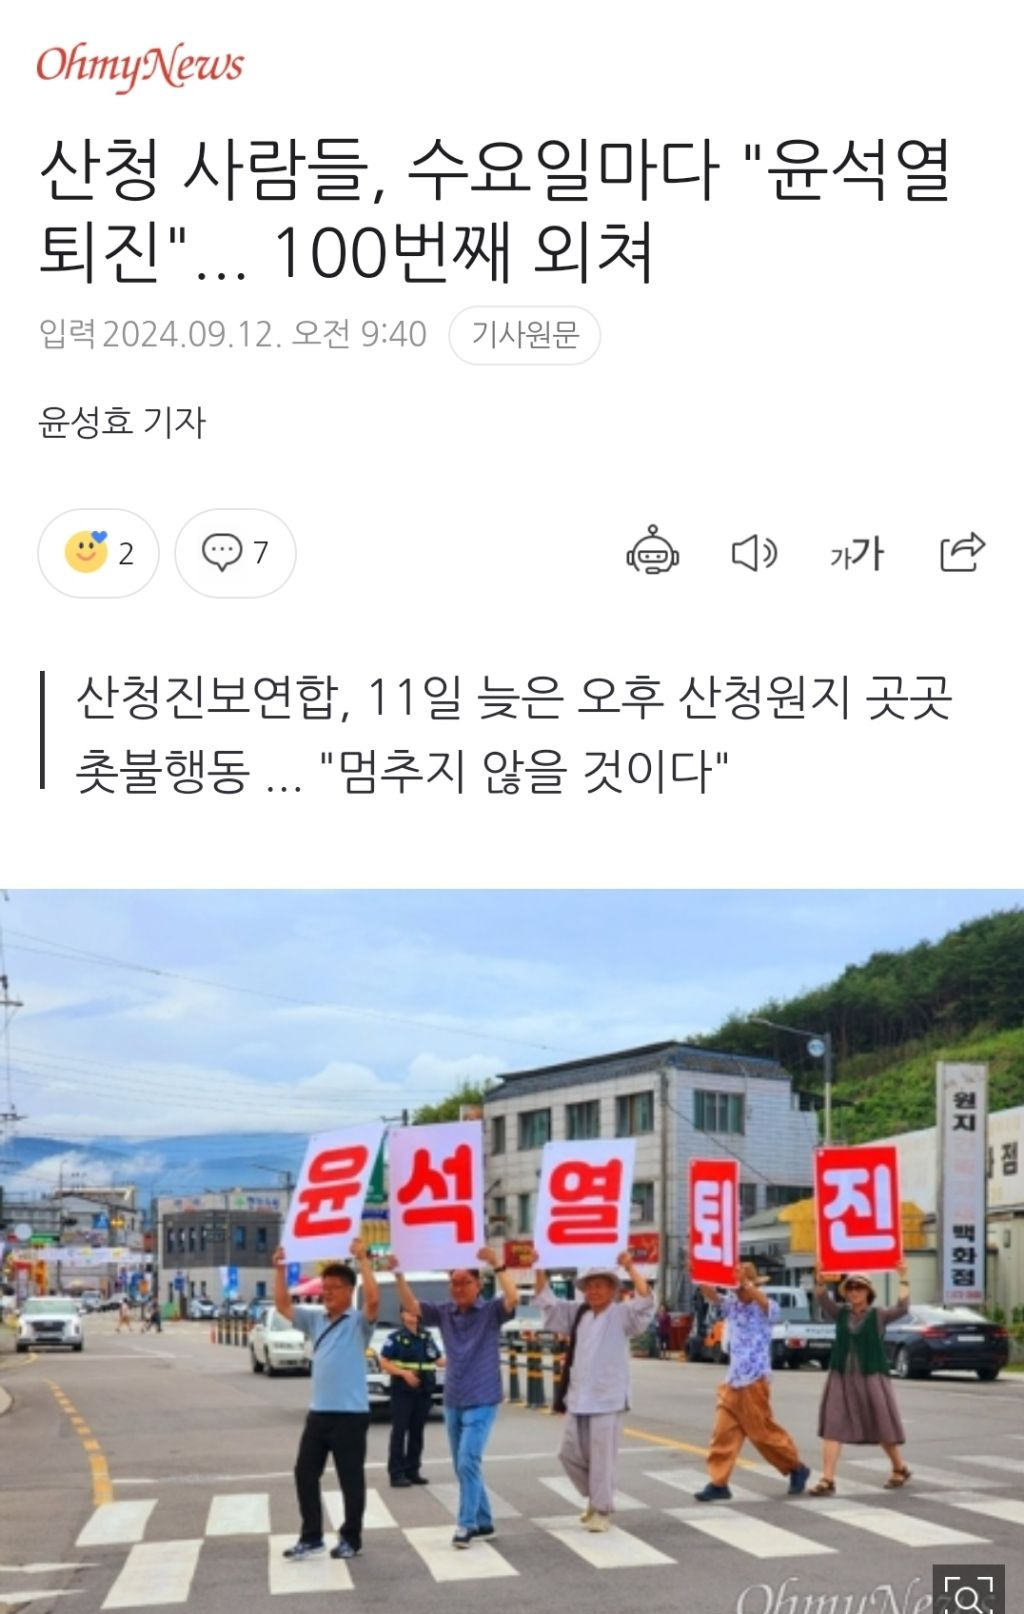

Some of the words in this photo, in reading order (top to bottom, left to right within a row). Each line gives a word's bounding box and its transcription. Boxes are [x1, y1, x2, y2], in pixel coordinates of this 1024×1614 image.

[37, 42, 245, 95] OhmyNews
[41, 138, 155, 201] 산청
[184, 138, 383, 204] 사람들,
[408, 138, 720, 201] 수요일마다
[745, 138, 947, 201] "윤석열
[278, 221, 508, 284] 100번째
[535, 221, 649, 284] 외쳐
[41, 319, 93, 349] 입력
[104, 321, 281, 347] 2024.09.12.
[293, 319, 348, 349] 오전
[362, 321, 426, 347] 9:40
[474, 321, 579, 349] 기사원문
[38, 406, 133, 440] 윤성효
[145, 406, 206, 439] 기자
[119, 542, 133, 565] 2
[254, 541, 268, 564] 7
[77, 675, 348, 723] 산청진보연합,
[371, 675, 460, 720] 11일
[478, 675, 564, 720] 늦은
[578, 675, 664, 720] 오후
[679, 675, 847, 720] 산청원지
[866, 676, 952, 720] 곳곳
[76, 749, 250, 794] 촛불행동
[321, 750, 462, 794] "멈추지
[484, 750, 567, 795] 않을
[585, 750, 727, 794] 것이다"
[953, 1091, 976, 1131] 원지
[952, 1225, 976, 1286] 백화점
